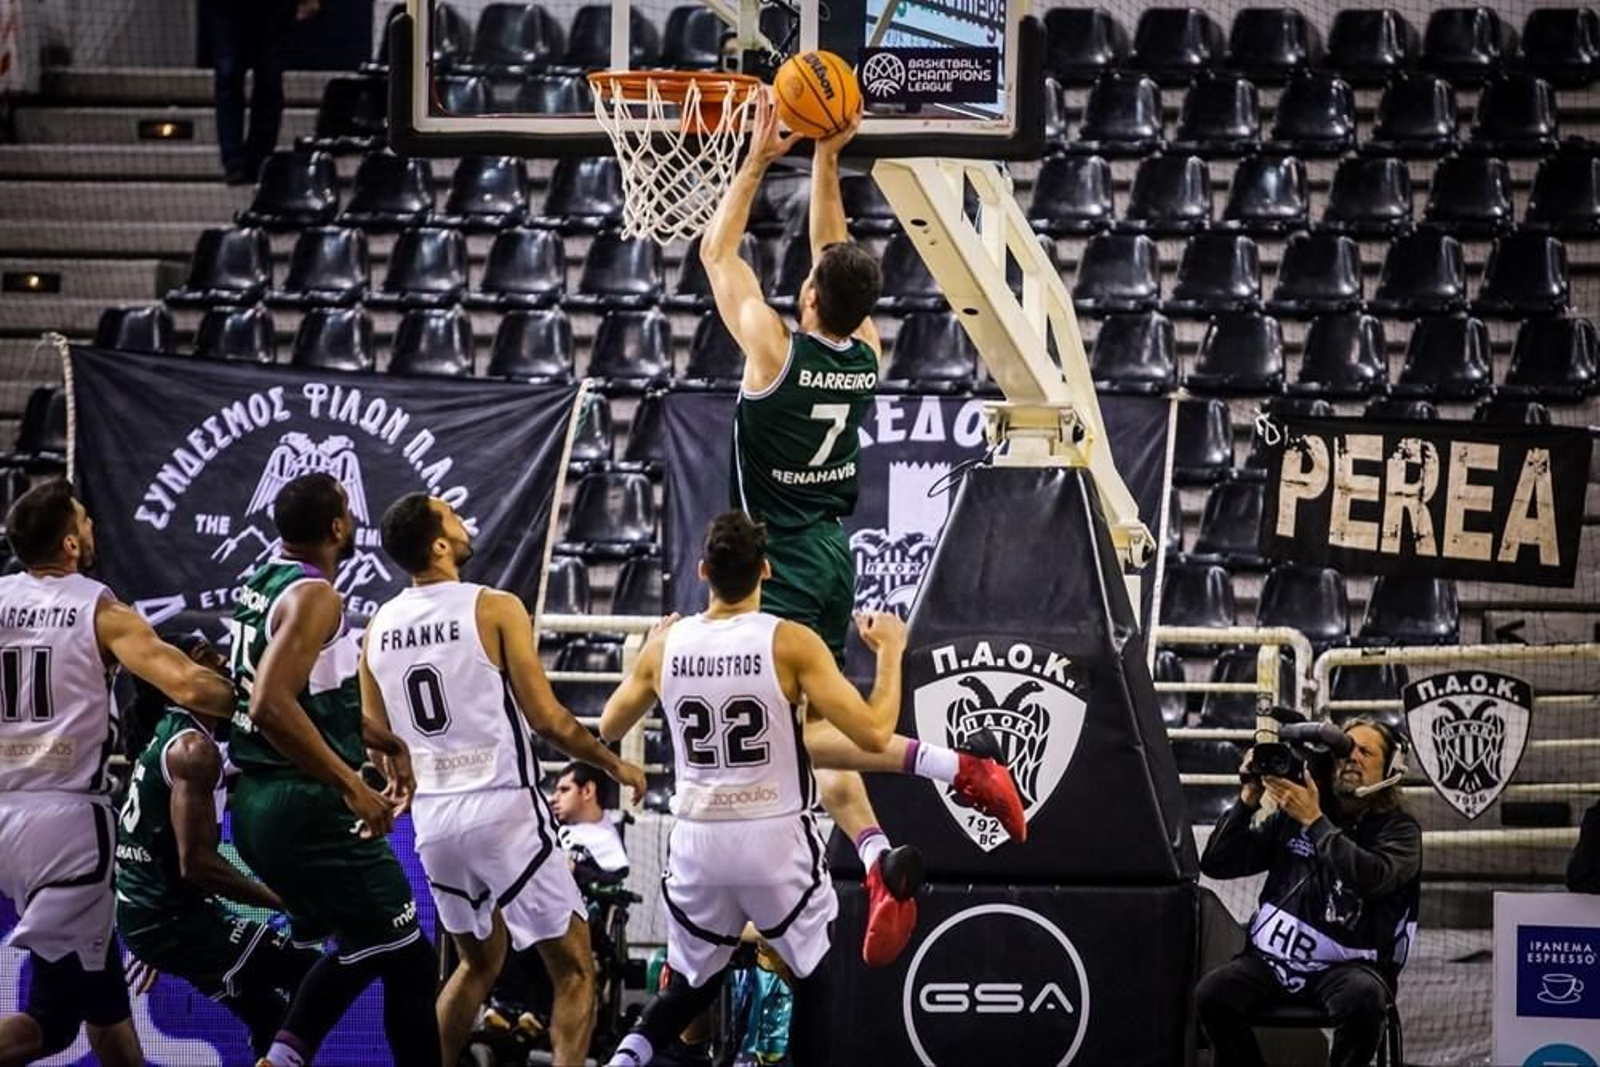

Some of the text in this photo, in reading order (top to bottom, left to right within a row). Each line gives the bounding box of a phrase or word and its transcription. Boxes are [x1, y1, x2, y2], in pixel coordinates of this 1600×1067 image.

[908, 58, 982, 69] BASKETBALL
[908, 70, 992, 82] CHAMPIONS
[908, 82, 953, 92] LEAGUE
[799, 370, 877, 390] BARREIRO
[810, 403, 851, 467] 7
[134, 386, 291, 530] ΣΥΝΔΕΣΜΟΣ
[1276, 433, 1560, 567] PEREA
[195, 514, 231, 535] THE
[380, 620, 460, 652] FRANKE
[671, 654, 762, 677] SALOUSTROS
[931, 641, 1076, 690] Π.Α.Ο.Κ.
[0, 645, 54, 722] 11
[1416, 673, 1520, 703] Π.Α.Ο.Κ.
[402, 663, 453, 738] 0
[674, 694, 770, 770] 22
[965, 714, 1030, 736] ΠΑΟΚ
[966, 814, 1000, 833] 192
[979, 834, 998, 846] BC
[1529, 940, 1592, 953] IPANEMA
[919, 982, 1075, 1013] GSA
